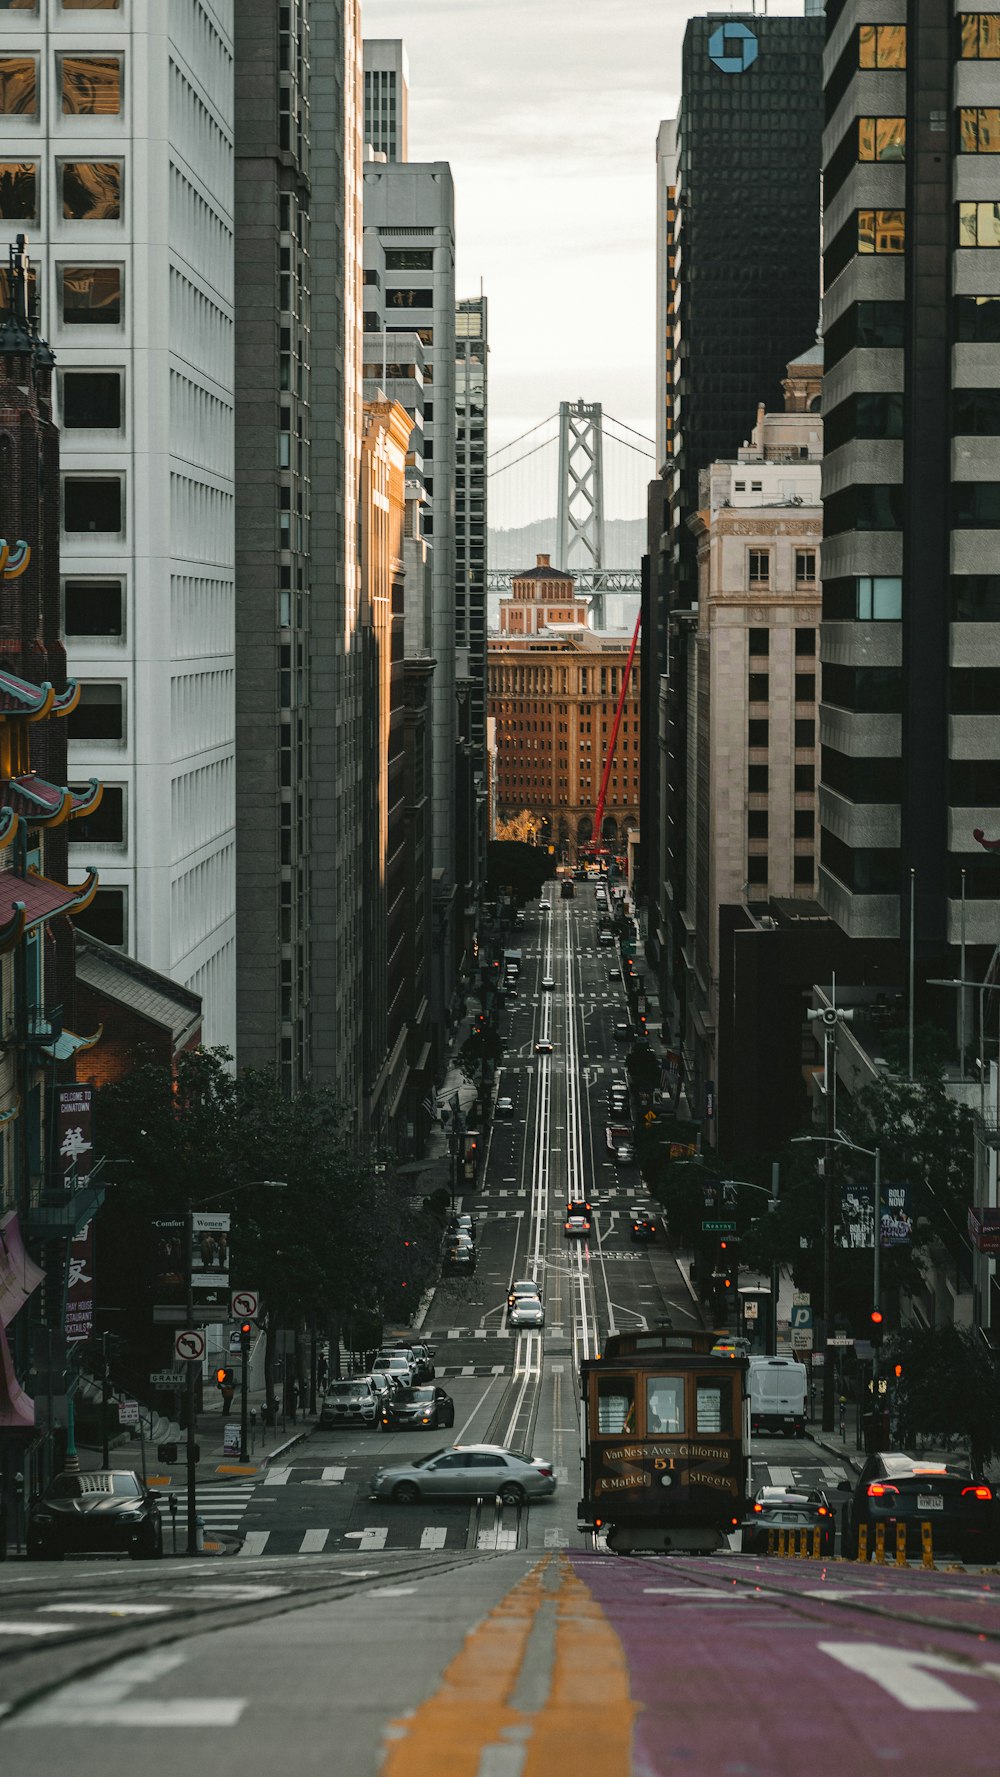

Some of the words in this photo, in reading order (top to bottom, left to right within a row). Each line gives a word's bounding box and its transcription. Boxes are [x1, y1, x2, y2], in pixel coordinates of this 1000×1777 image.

[60, 1092, 83, 1102] WELCOME
[84, 1091, 91, 1100] TO
[61, 1103, 90, 1113] CHINATOWN
[889, 1189, 905, 1197] BOLD
[889, 1198, 905, 1207] NOW
[849, 1224, 866, 1233] BOLD
[850, 1233, 867, 1241] THEN
[78, 1300, 92, 1310] HOUSE
[66, 1312, 92, 1322] STAURANT
[605, 1449, 623, 1460] Van
[624, 1446, 648, 1459] Ness
[679, 1446, 729, 1459] California
[654, 1458, 676, 1470] 51
[601, 1479, 610, 1488] &
[611, 1474, 647, 1487] Market
[690, 1473, 731, 1487] Streets
